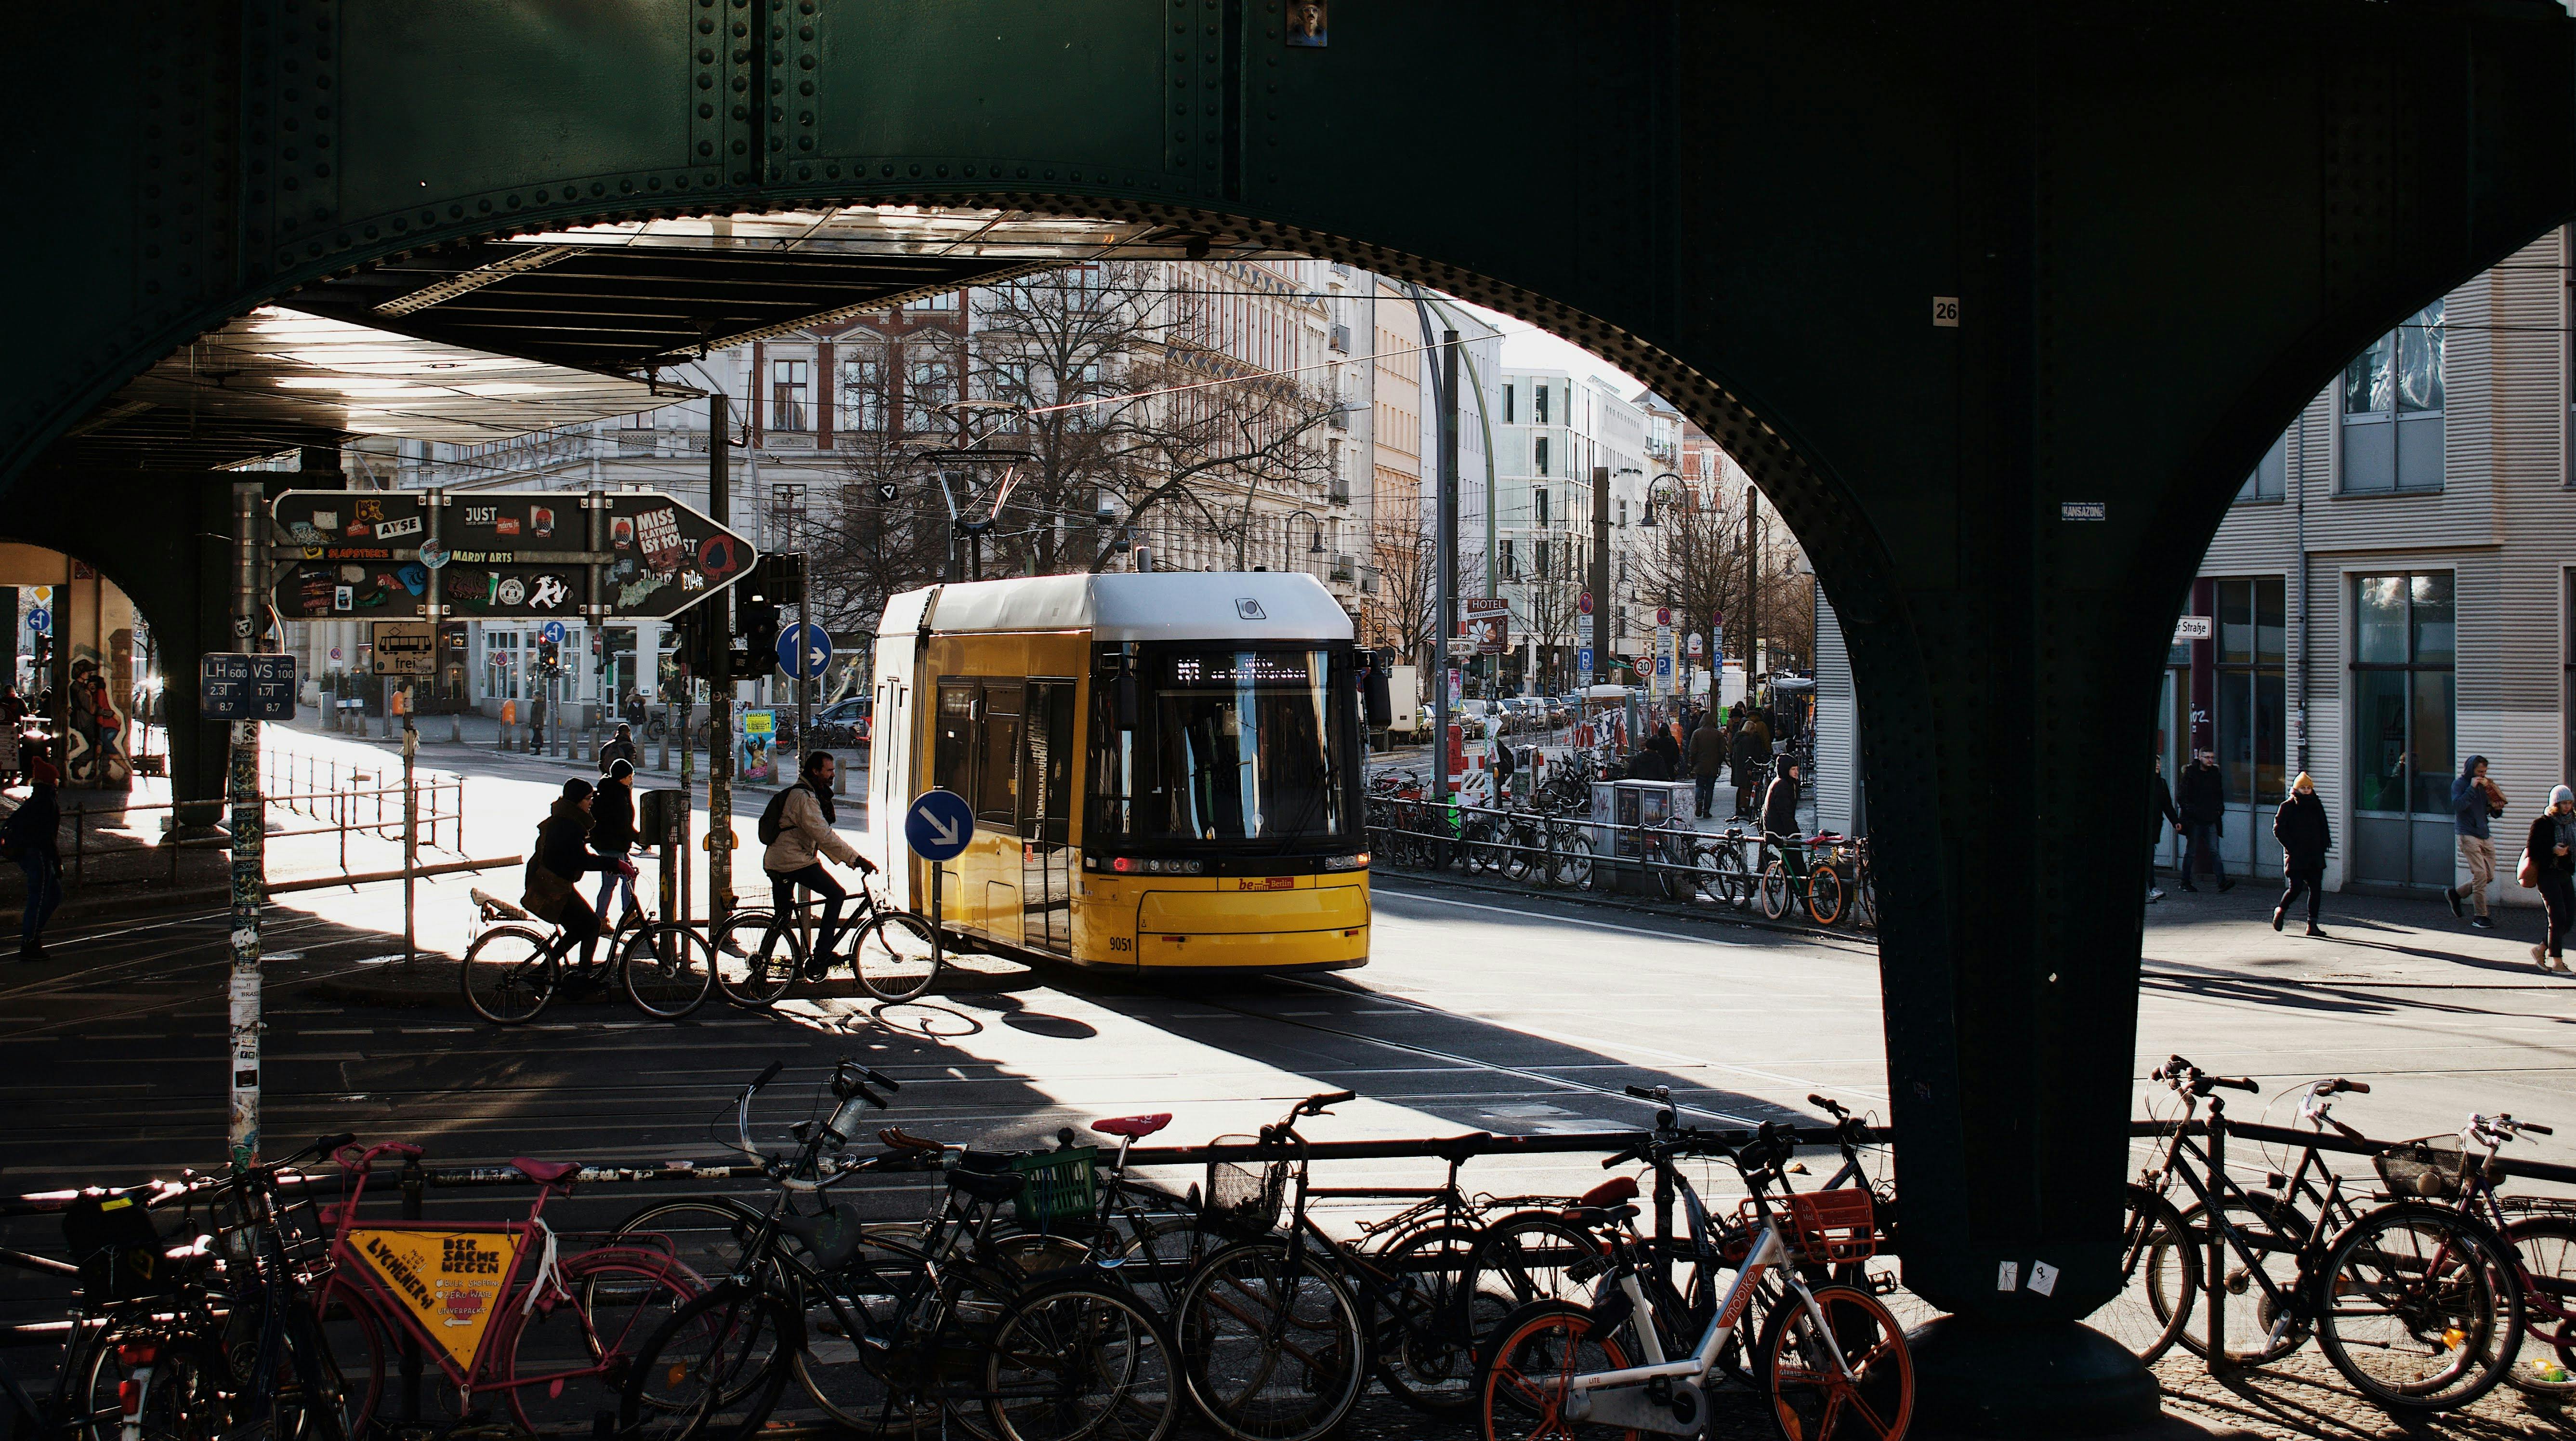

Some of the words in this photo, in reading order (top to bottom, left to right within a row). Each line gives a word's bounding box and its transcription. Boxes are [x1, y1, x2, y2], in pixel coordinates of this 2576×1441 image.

[1936, 303, 1957, 320] 26
[465, 507, 498, 521] JUST
[636, 507, 676, 531] MISS
[639, 523, 679, 541] PLATNUM
[452, 550, 486, 562] MARDY
[489, 553, 512, 563] ARTS
[1472, 600, 1503, 609] HOTEL
[2182, 622, 2206, 635] Straße
[395, 658, 416, 669] frei
[1637, 662, 1649, 671] 30
[1658, 659, 1666, 673] P
[1716, 654, 1721, 666] P
[206, 663, 226, 677] LH
[230, 669, 247, 678] 600
[253, 664, 273, 678] VS
[278, 670, 294, 678] 100
[1239, 878, 1253, 890] be
[1110, 937, 1131, 952] 9051
[2205, 1195, 2232, 1229] touring
[443, 1239, 476, 1251] DER
[443, 1250, 499, 1262] SACHE
[368, 1238, 426, 1300] LYCHENER
[442, 1261, 499, 1273] WEGEN
[1726, 1271, 1756, 1322] mobike
